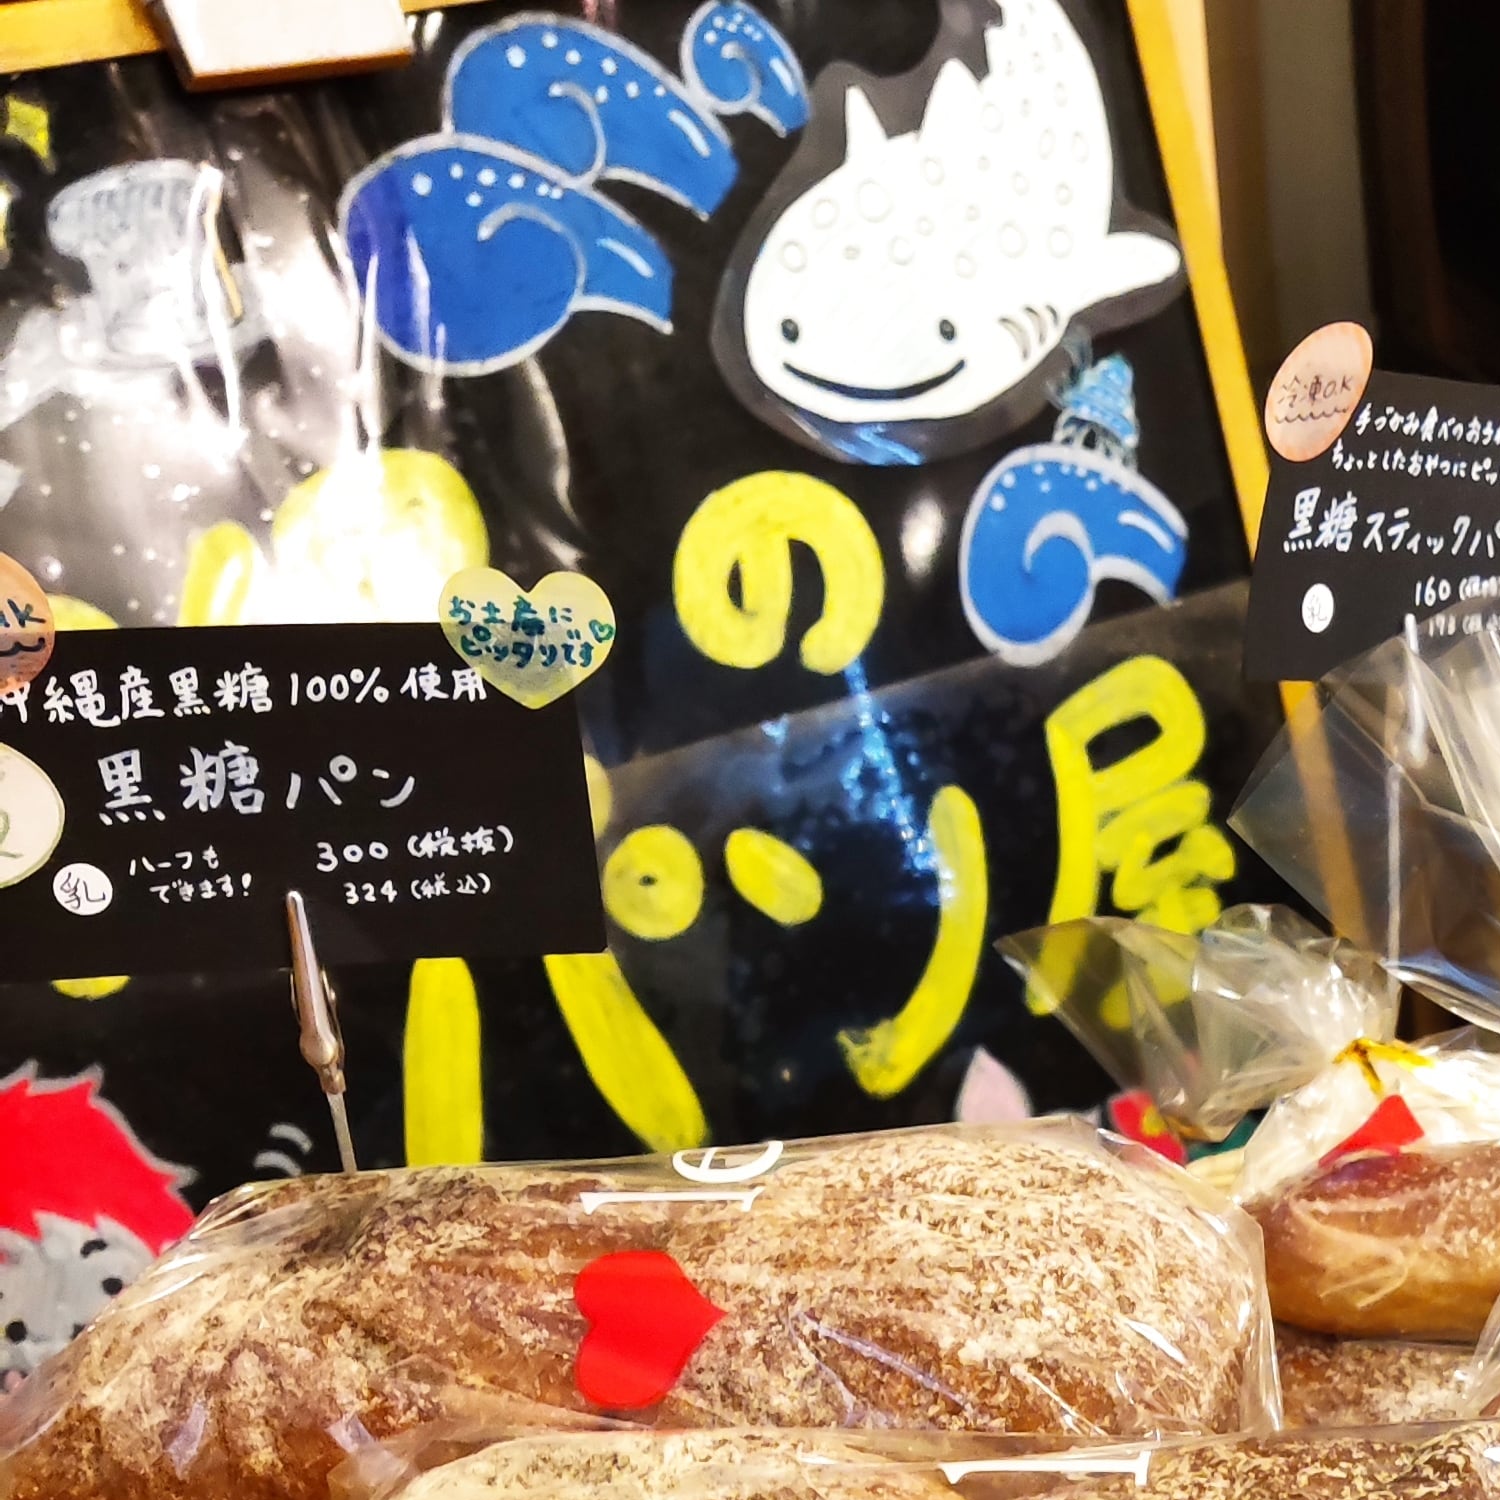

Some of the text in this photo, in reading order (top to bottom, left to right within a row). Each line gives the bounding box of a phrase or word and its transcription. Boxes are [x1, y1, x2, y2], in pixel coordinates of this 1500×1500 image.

[1415, 575, 1452, 607] 160
[449, 595, 574, 637] お土産に
[460, 623, 595, 670] ピッタリです
[97, 738, 417, 825] 黒糖パン
[128, 844, 220, 877] ハーフも
[316, 824, 515, 873] 300 (税抜)
[60, 871, 107, 911] 乳
[343, 871, 492, 905] 324 (税込)
